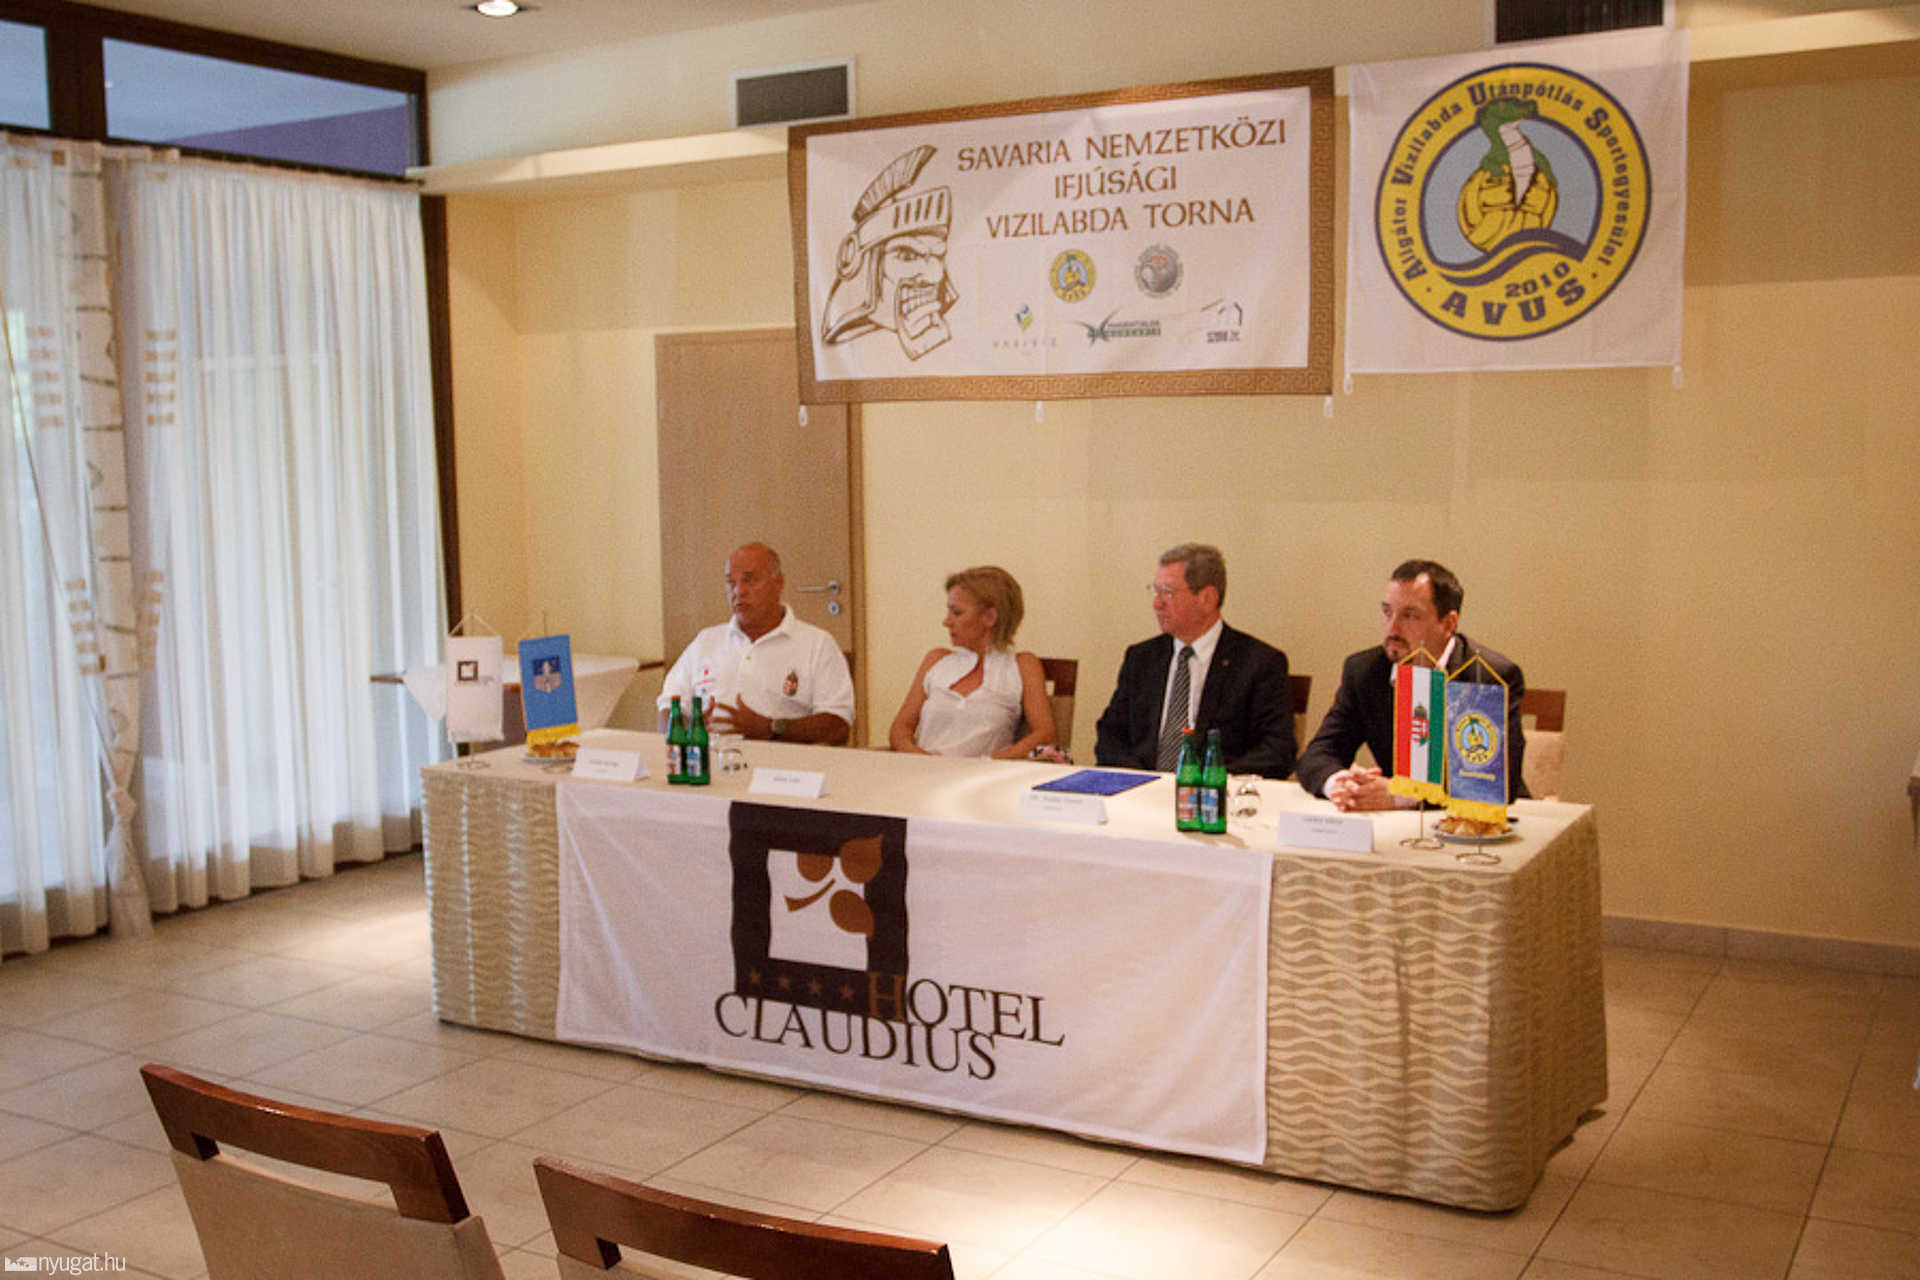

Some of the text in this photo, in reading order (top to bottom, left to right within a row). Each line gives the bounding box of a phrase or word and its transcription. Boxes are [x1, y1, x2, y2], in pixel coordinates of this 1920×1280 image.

[957, 116, 1286, 171] SAVARIA NEMZETKÖZI
[1055, 160, 1177, 200] IFJÚSÁGI
[986, 198, 1255, 239] VIZILABDA TORNA
[1440, 277, 1586, 325] AVUS
[1505, 261, 1570, 298] 2010
[868, 971, 1065, 1047] HOTEL
[714, 991, 996, 1081] CLAUDIUS
